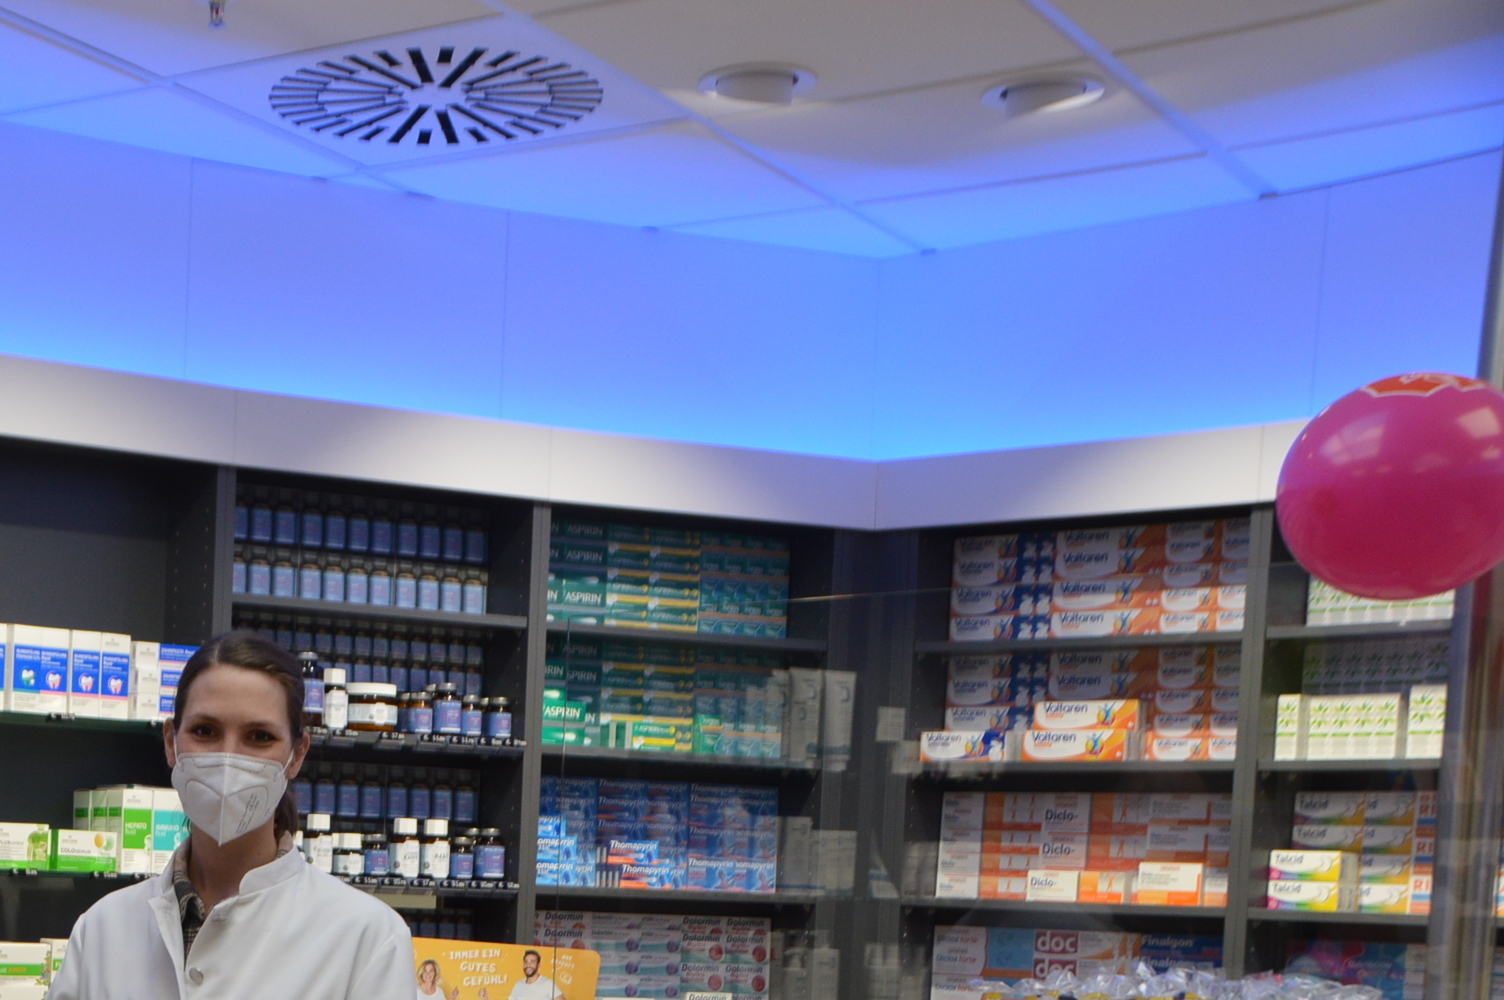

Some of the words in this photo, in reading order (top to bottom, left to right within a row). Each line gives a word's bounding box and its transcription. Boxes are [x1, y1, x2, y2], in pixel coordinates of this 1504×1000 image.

[1063, 551, 1109, 564] Voltaren
[1060, 581, 1106, 594] Voltaren
[565, 591, 602, 603] ASPIRIN
[1059, 612, 1104, 625] Voltaren
[567, 669, 598, 681] SPIRIN
[1056, 674, 1101, 686] Voltaren
[544, 706, 581, 718] ASPIRIN
[1043, 701, 1088, 714] Voltaren
[1031, 731, 1077, 744] Voltaren
[1045, 808, 1079, 822] Diclo-
[125, 821, 147, 829] HEPATO
[537, 838, 575, 848] omapyrin
[610, 840, 658, 851] Thomapyrin
[1042, 842, 1075, 856] Diclo-
[688, 858, 734, 868] Thomapyrin
[1274, 853, 1304, 864] Talcid
[536, 862, 573, 872] omapyrin
[622, 864, 670, 875] Thomapyrin
[1273, 884, 1302, 894] Talcid
[683, 916, 721, 926] Dolormin
[682, 934, 721, 943] Dolormin
[1037, 932, 1076, 953] doc
[1142, 935, 1193, 948] Finalgon
[449, 950, 480, 960] IMMER
[482, 948, 501, 958] EIN
[460, 961, 496, 973] GUTES
[463, 973, 508, 987] GEFÜHL!
